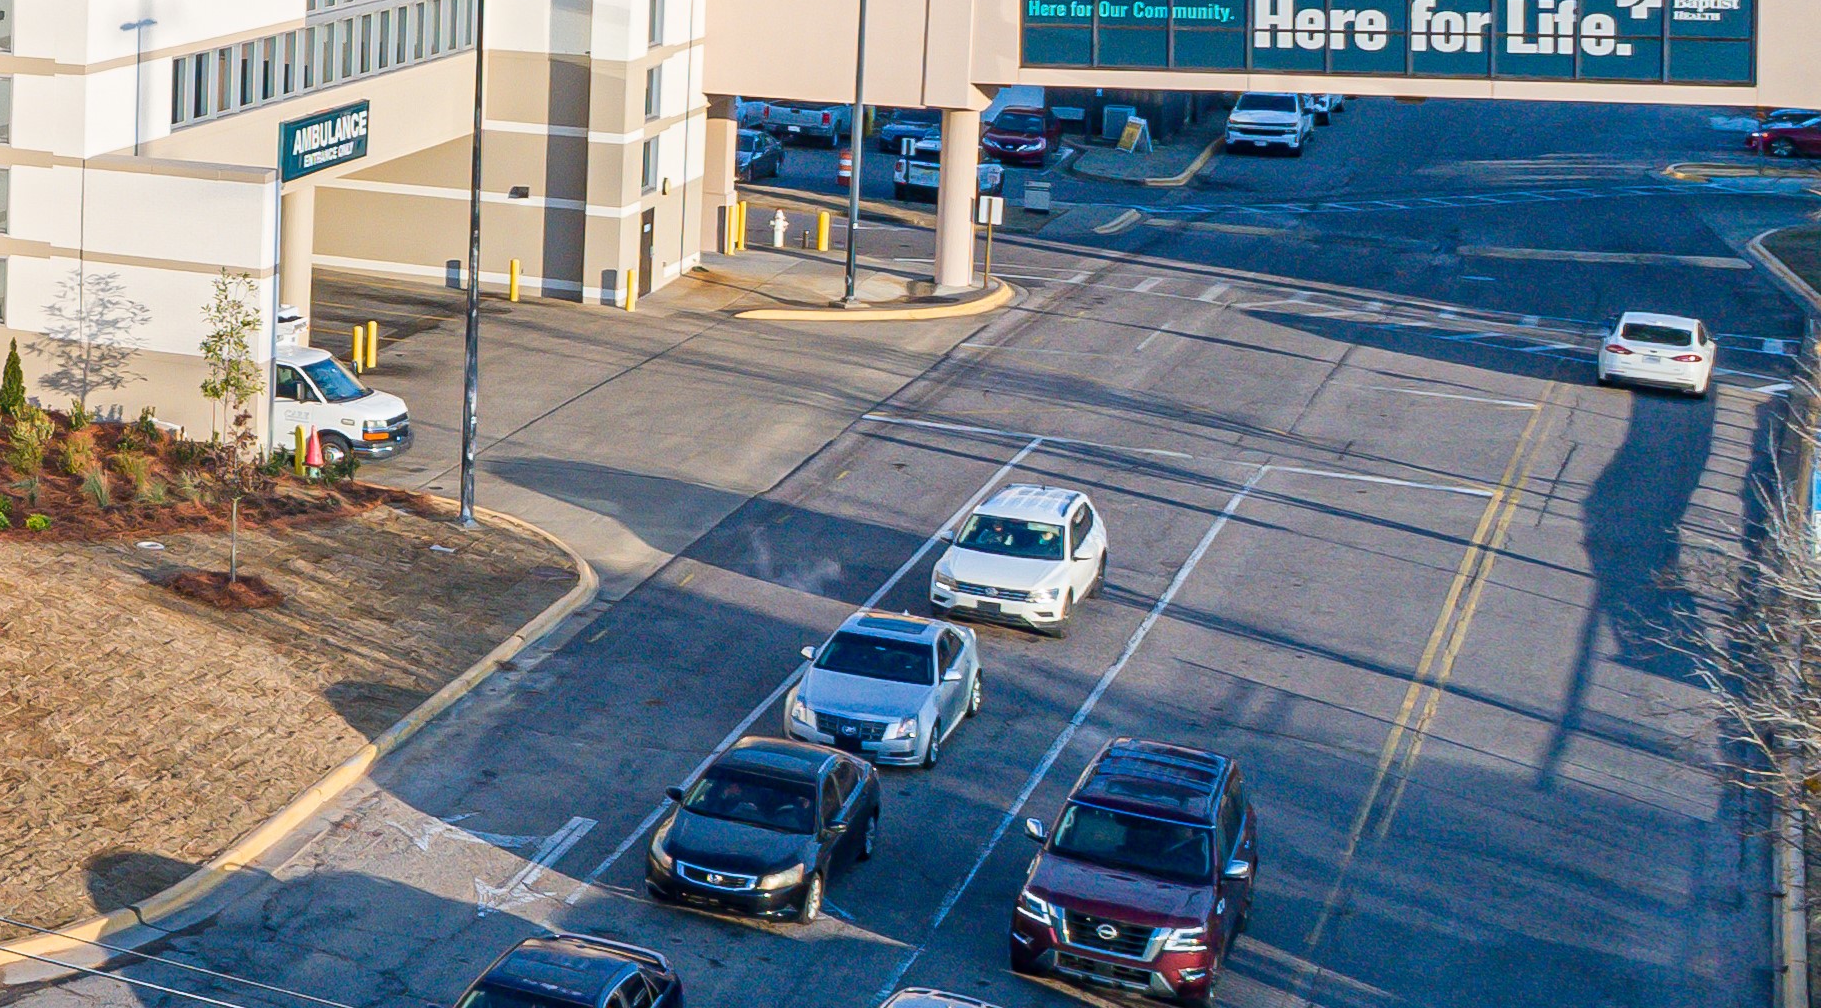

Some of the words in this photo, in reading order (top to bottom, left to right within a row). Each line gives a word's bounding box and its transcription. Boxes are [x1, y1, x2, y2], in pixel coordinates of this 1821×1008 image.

[1028, 0, 1066, 16] Here
[1070, 0, 1094, 17] for
[1098, 2, 1129, 18] Our
[1133, 1, 1235, 23] Community.
[292, 110, 367, 155] AMBULANCE
